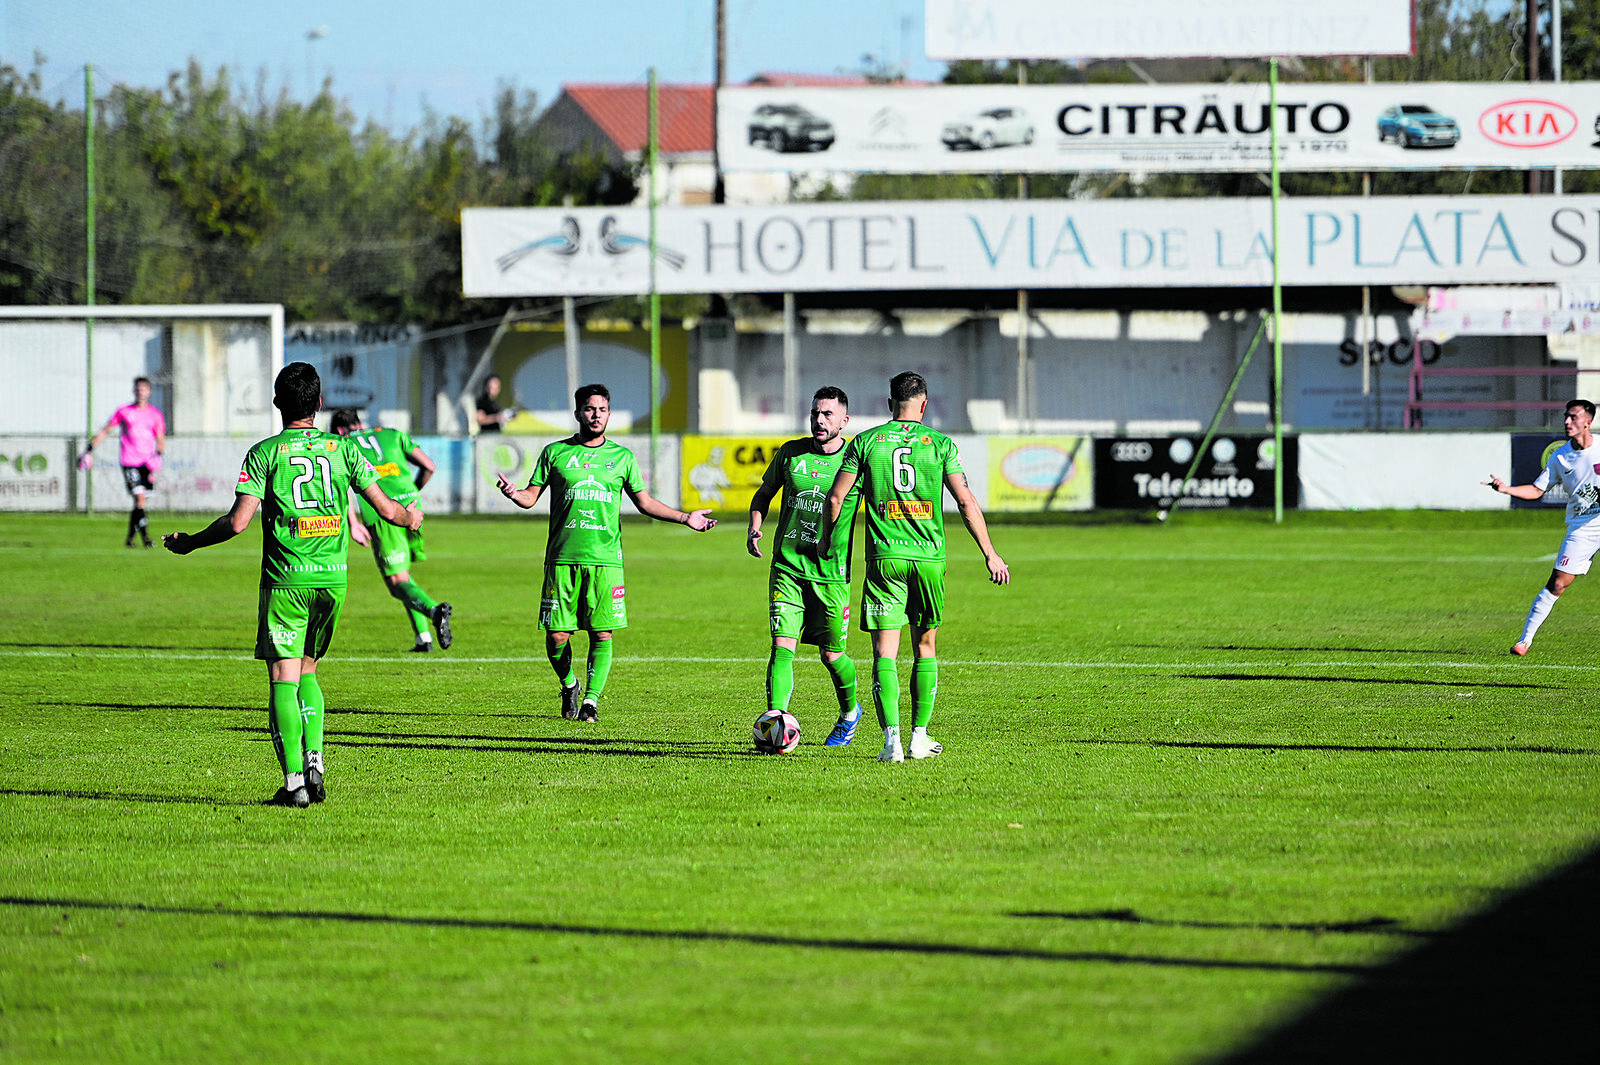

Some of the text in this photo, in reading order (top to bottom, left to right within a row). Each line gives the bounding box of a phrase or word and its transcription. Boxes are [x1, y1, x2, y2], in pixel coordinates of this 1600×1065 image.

[701, 207, 1600, 275] HOTEL VIA DE LA PLATA S
[357, 435, 383, 462] 4
[892, 446, 917, 494] 6
[290, 456, 335, 510] 21
[542, 611, 551, 625] 14
